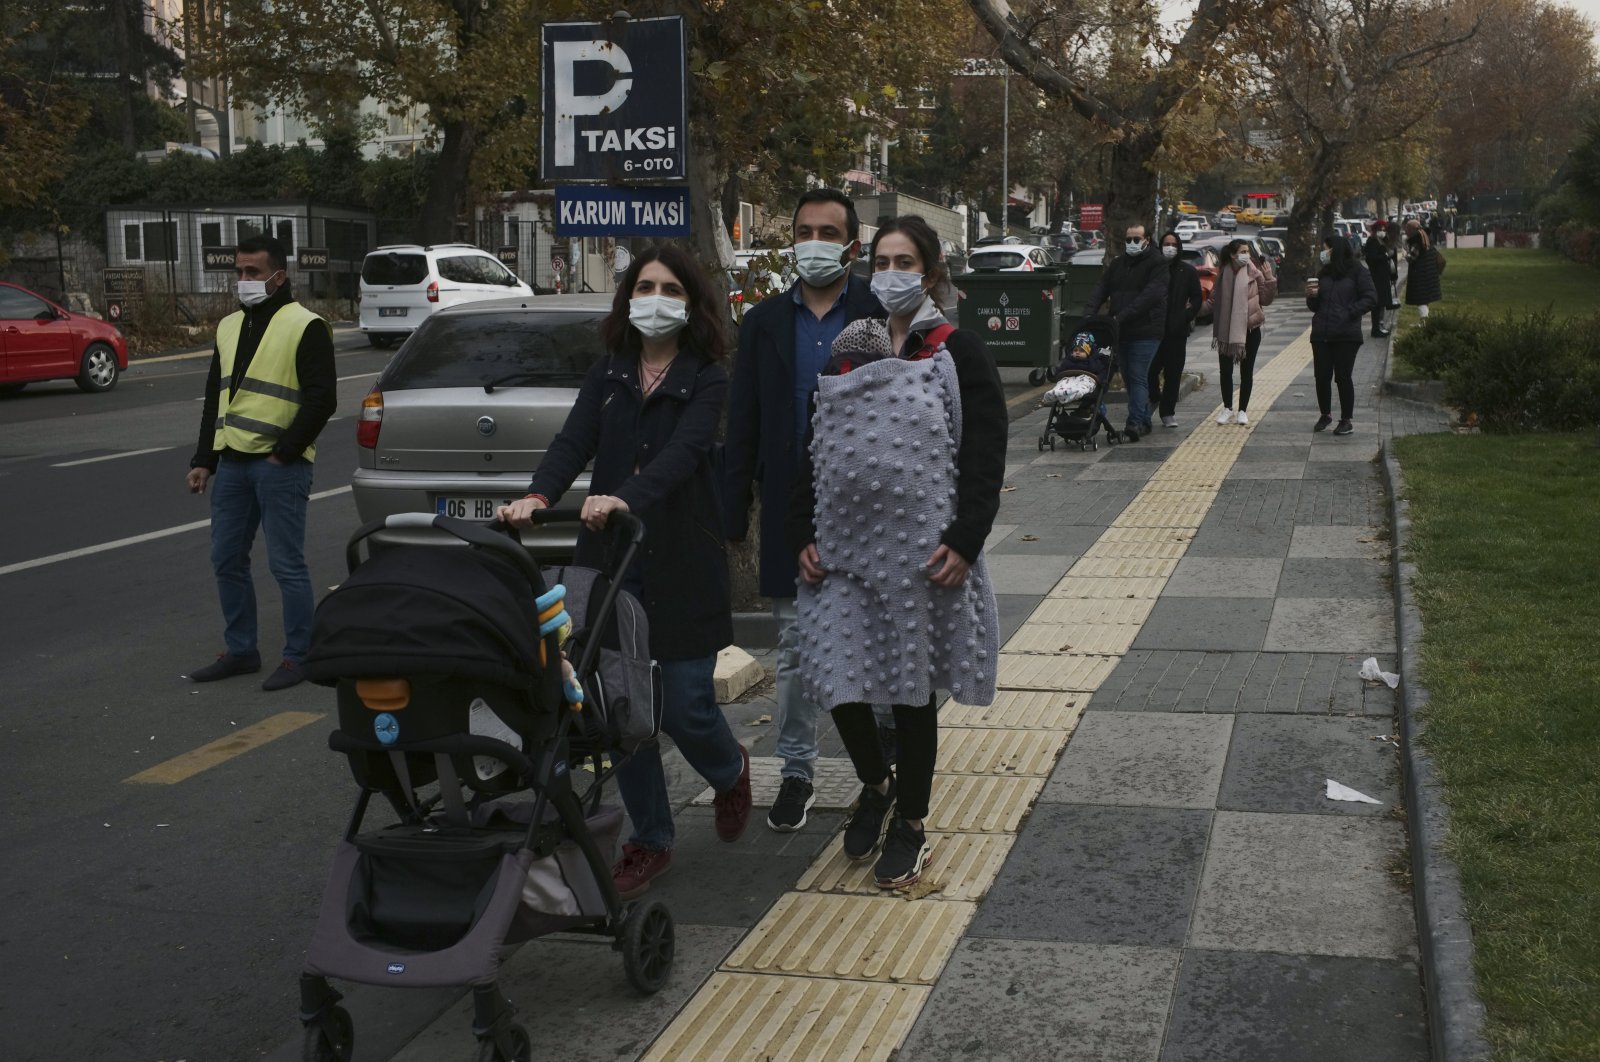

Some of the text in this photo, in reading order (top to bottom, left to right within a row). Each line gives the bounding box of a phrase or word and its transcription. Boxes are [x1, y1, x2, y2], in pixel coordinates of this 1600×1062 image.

[554, 40, 633, 166] P
[624, 157, 674, 171] 6-OTO
[560, 196, 685, 226] KARUM TAKSİ
[215, 254, 235, 264] YDS
[308, 255, 327, 265] YDS
[448, 500, 466, 518] 06
[474, 500, 493, 518] HB
